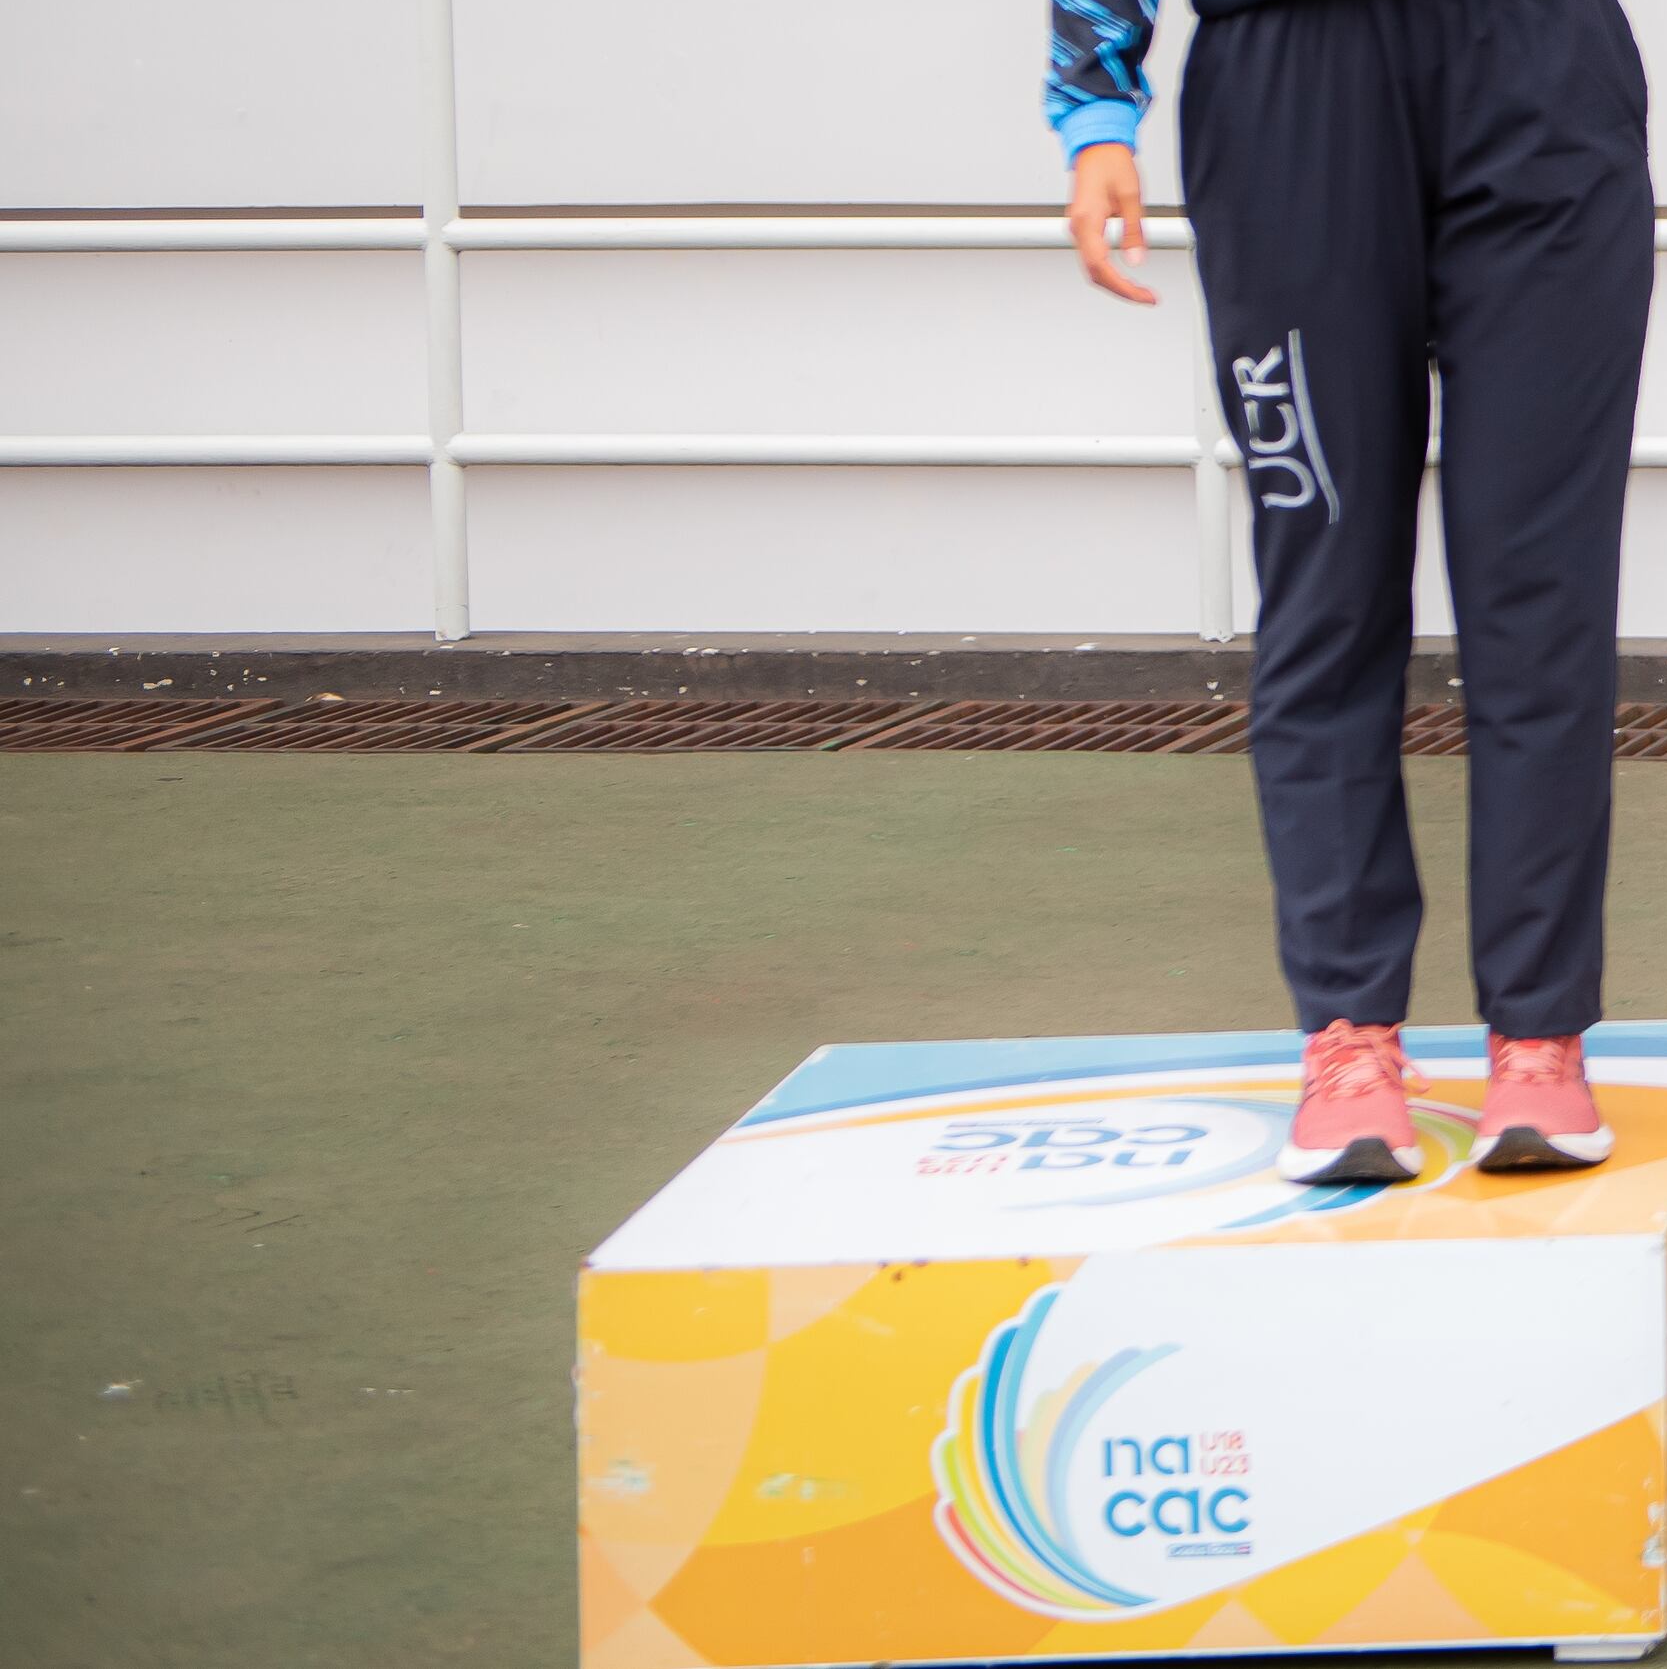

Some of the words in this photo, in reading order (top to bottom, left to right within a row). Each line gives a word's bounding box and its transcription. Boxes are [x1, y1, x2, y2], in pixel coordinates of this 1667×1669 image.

[1232, 345, 1316, 509] UCR
[1104, 1435, 1190, 1477] na
[1105, 1486, 1250, 1537] cac
